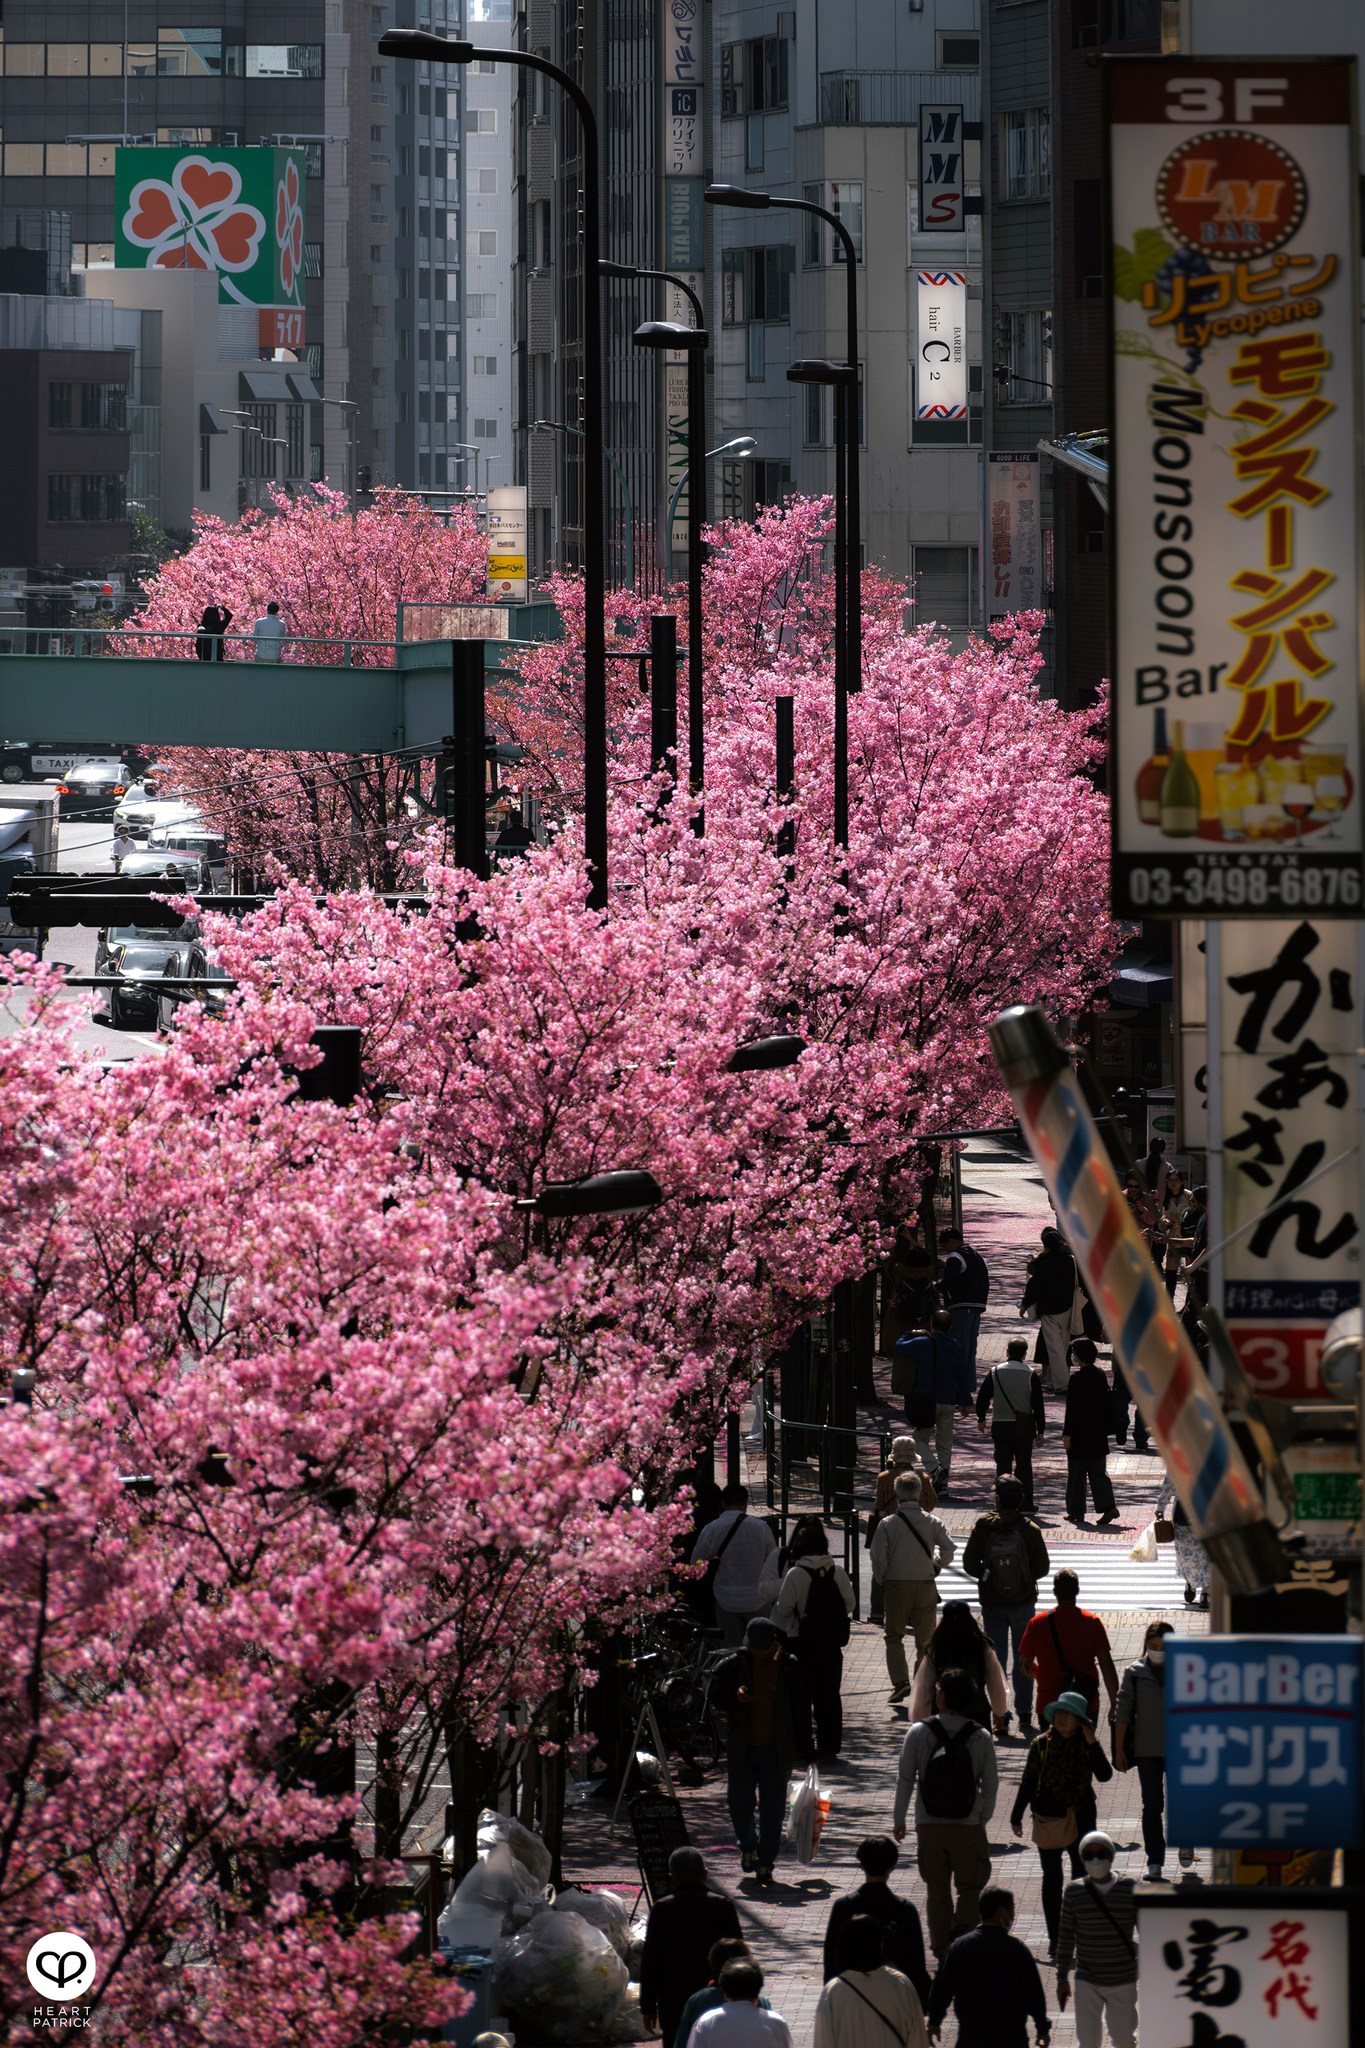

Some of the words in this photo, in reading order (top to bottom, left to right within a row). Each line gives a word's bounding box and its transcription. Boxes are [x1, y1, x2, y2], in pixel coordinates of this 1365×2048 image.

[1165, 77, 1290, 123] 3F
[673, 118, 684, 173] クリニック
[685, 118, 696, 160] アイシー
[923, 112, 961, 224] MMS
[1175, 159, 1285, 223] LM
[1201, 222, 1262, 243] BAR
[1140, 252, 1338, 327] リコピン
[276, 312, 302, 344] ライフ
[928, 306, 941, 331] hair
[1176, 296, 1323, 347] Lycopene
[922, 340, 951, 363] C
[953, 327, 962, 363] BARBER
[1151, 383, 1205, 657] Monsoon
[1226, 331, 1335, 747] モンスーンバル
[1134, 662, 1229, 706] Bar
[48, 759, 74, 768] TAXI
[1194, 853, 1230, 867] TEL
[1237, 853, 1254, 867] &
[1258, 853, 1299, 867] FAX
[1129, 867, 1361, 905] 03-3498-6876
[1173, 1651, 1359, 1706] BarBer
[1180, 1724, 1348, 1787] サンクス
[1219, 1802, 1310, 1840] 2F
[1259, 1920, 1318, 2021] 名代
